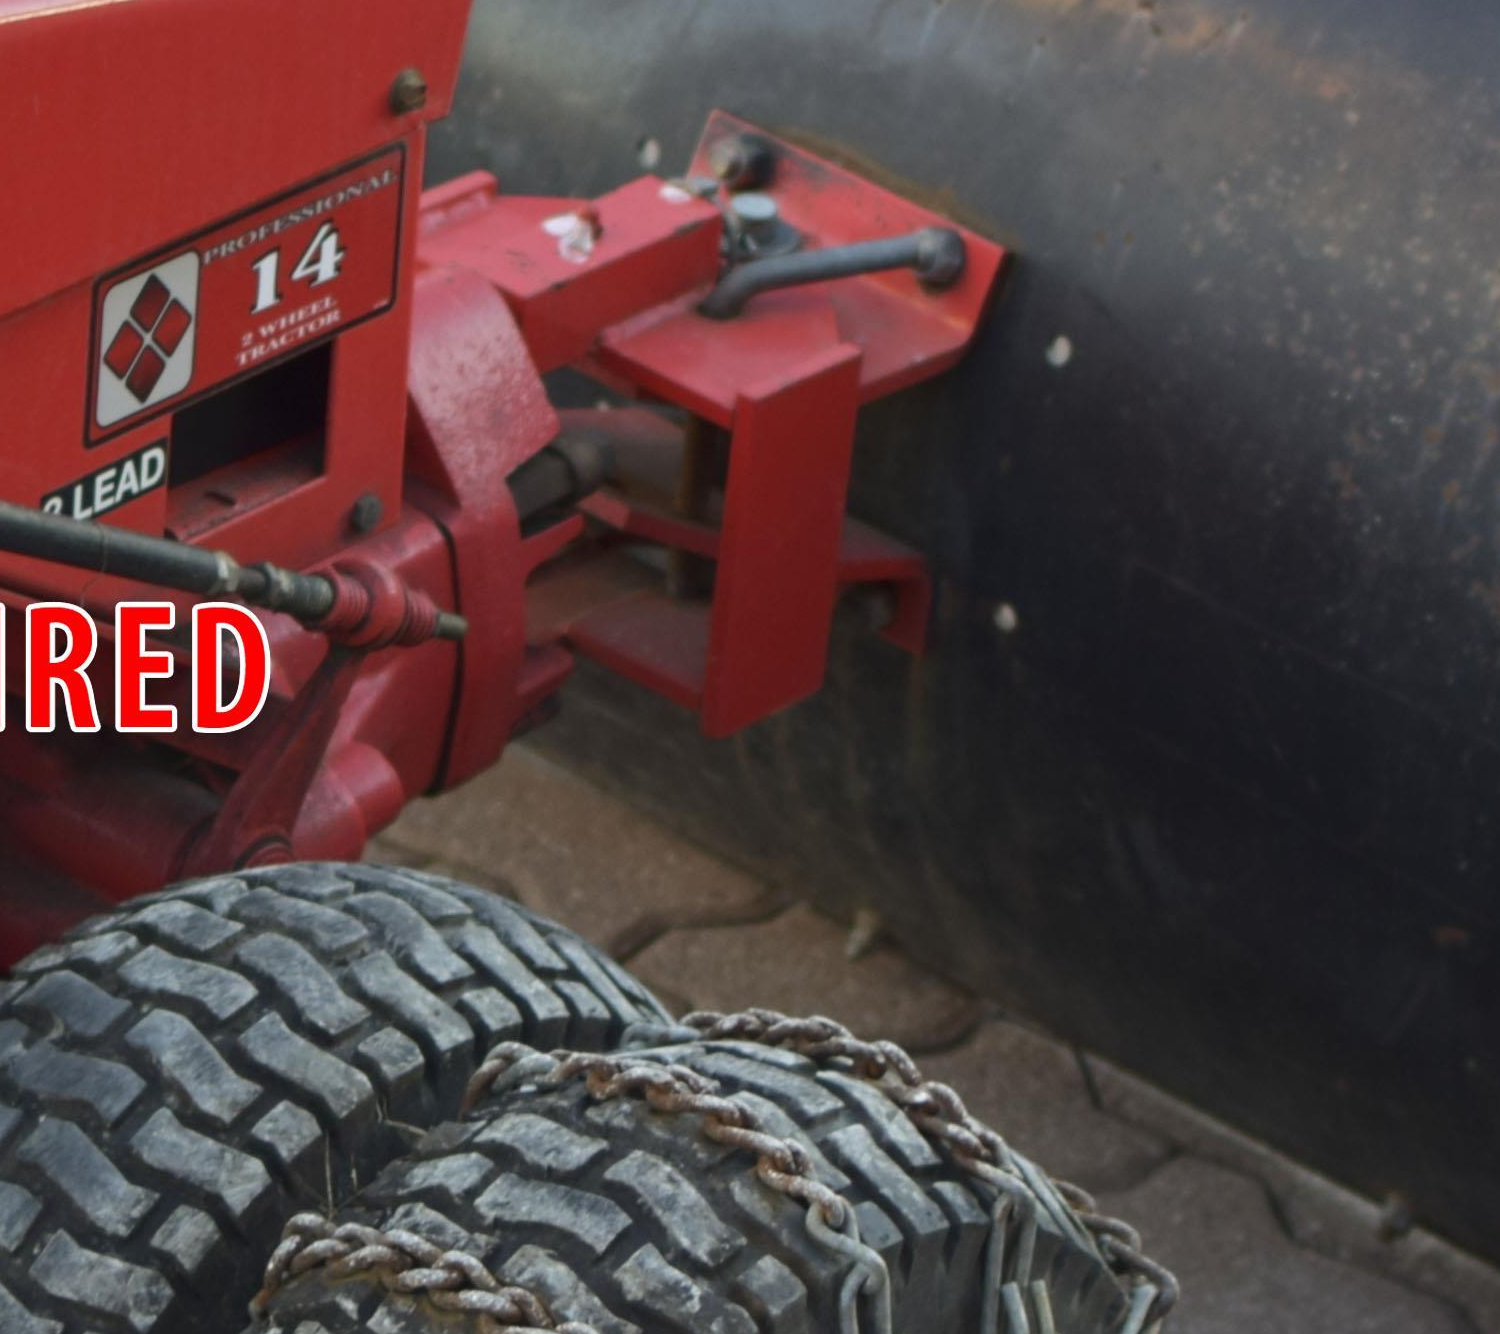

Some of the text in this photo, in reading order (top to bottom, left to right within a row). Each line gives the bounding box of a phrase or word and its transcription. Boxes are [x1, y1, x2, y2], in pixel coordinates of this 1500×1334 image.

[203, 169, 397, 266] PROFESSIONAL
[250, 218, 347, 314] 14
[236, 310, 341, 366] TRACTOR
[241, 295, 337, 347] 2 WHEEL
[73, 447, 165, 520] LEAD
